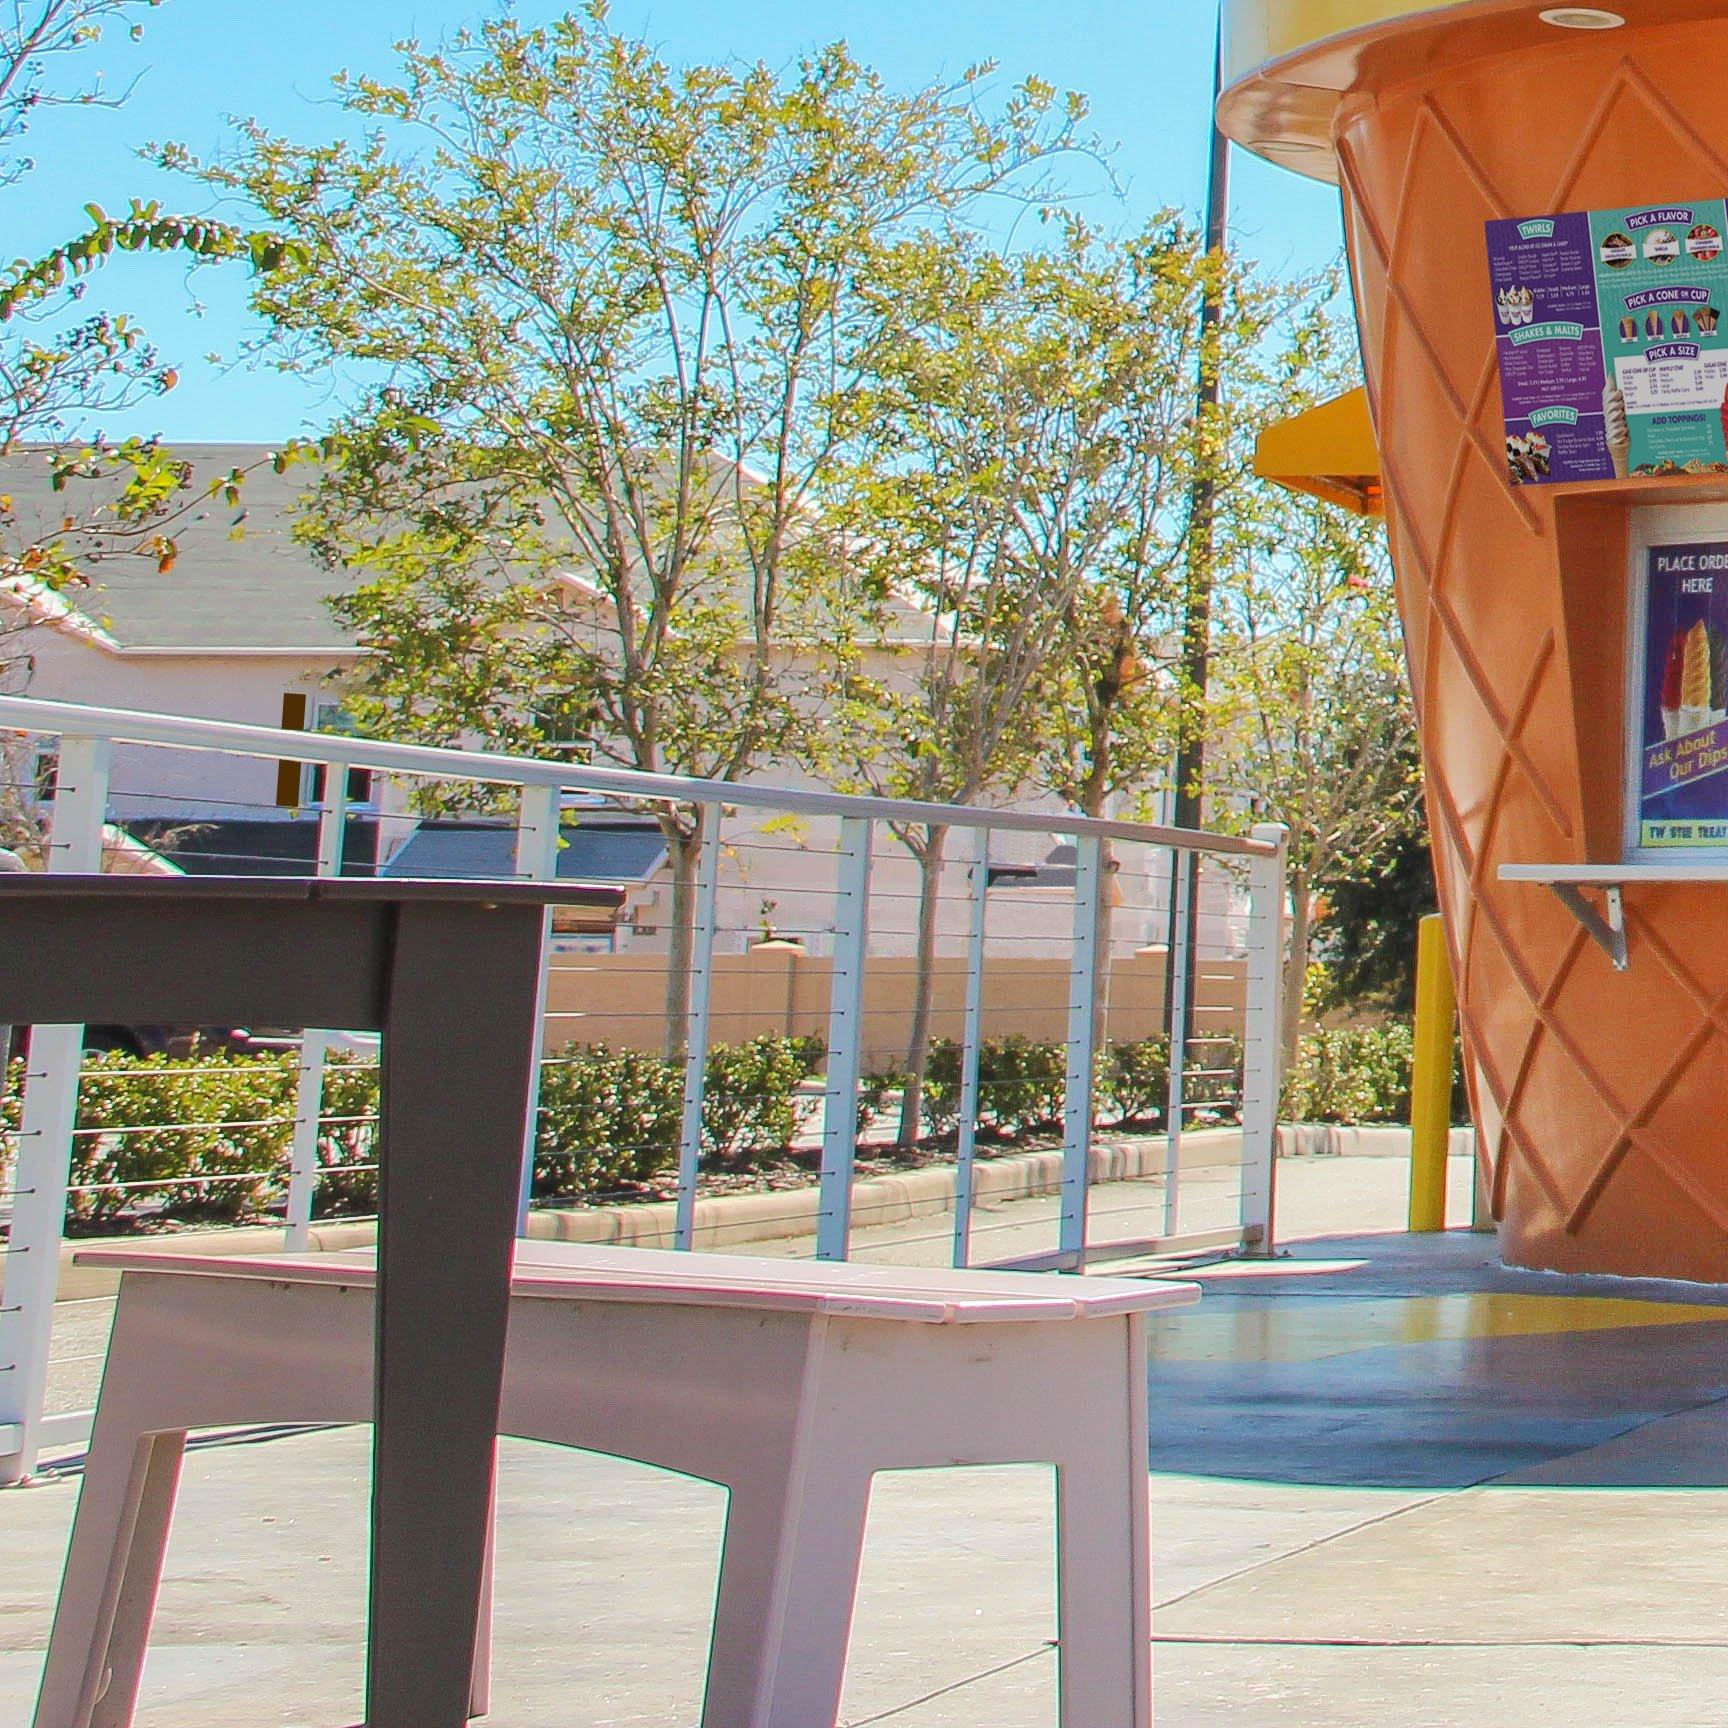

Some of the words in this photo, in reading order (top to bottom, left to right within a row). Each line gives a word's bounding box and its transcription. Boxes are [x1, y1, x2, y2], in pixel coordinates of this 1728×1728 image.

[1630, 216, 1647, 227] PICK
[1650, 214, 1656, 223] A
[1657, 212, 1689, 222] FLAVOR
[1521, 224, 1551, 236] TWIRLS
[1628, 296, 1646, 307] PICK
[1649, 293, 1654, 302] A
[1656, 291, 1678, 300] CONE
[1691, 291, 1707, 300] CUP
[1514, 328, 1544, 341] SHAKES
[1546, 327, 1552, 335] &
[1555, 326, 1579, 336] MALTS
[1649, 347, 1668, 359] PICK
[1670, 347, 1676, 355] A
[1678, 346, 1695, 356] SIZE
[1532, 411, 1575, 423] FAVORITES
[1652, 417, 1667, 425] ADD
[1669, 414, 1706, 424] TOPPINGS!
[1658, 556, 1696, 571] PLACE
[1682, 578, 1713, 592] HERE
[1649, 749, 1673, 769] Ask
[1676, 731, 1716, 758] About
[1670, 760, 1694, 779] Our
